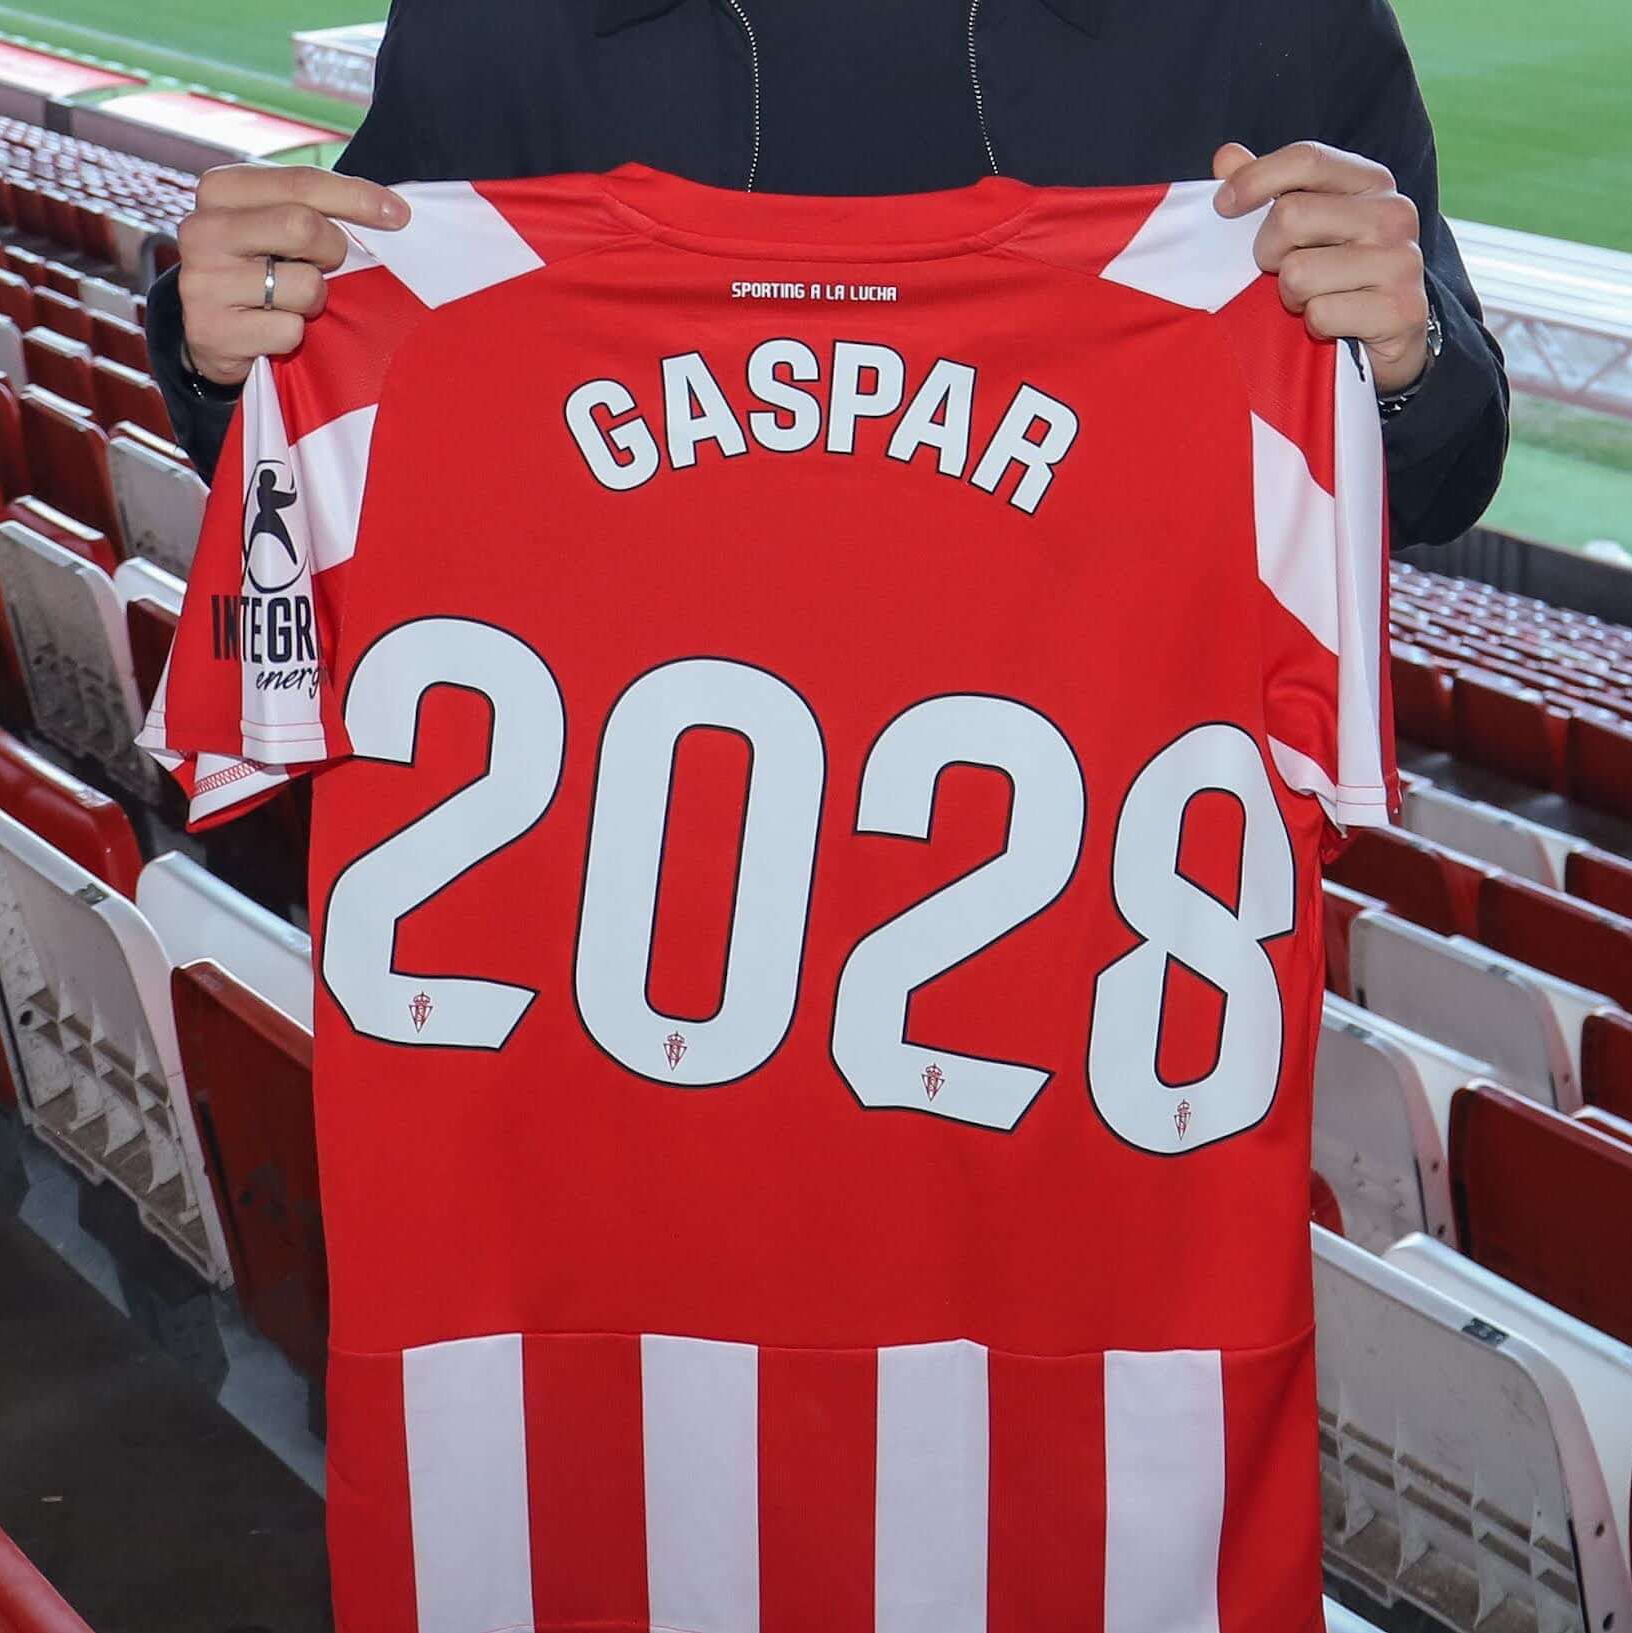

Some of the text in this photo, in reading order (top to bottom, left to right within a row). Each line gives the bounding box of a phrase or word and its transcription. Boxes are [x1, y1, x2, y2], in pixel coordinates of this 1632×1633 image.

[731, 281, 897, 302] SPORTING A LA LUCHA
[563, 337, 1079, 516] GASPAR
[211, 594, 323, 664] INTEGR
[255, 666, 328, 699] energ
[321, 614, 1296, 1157] 2028
